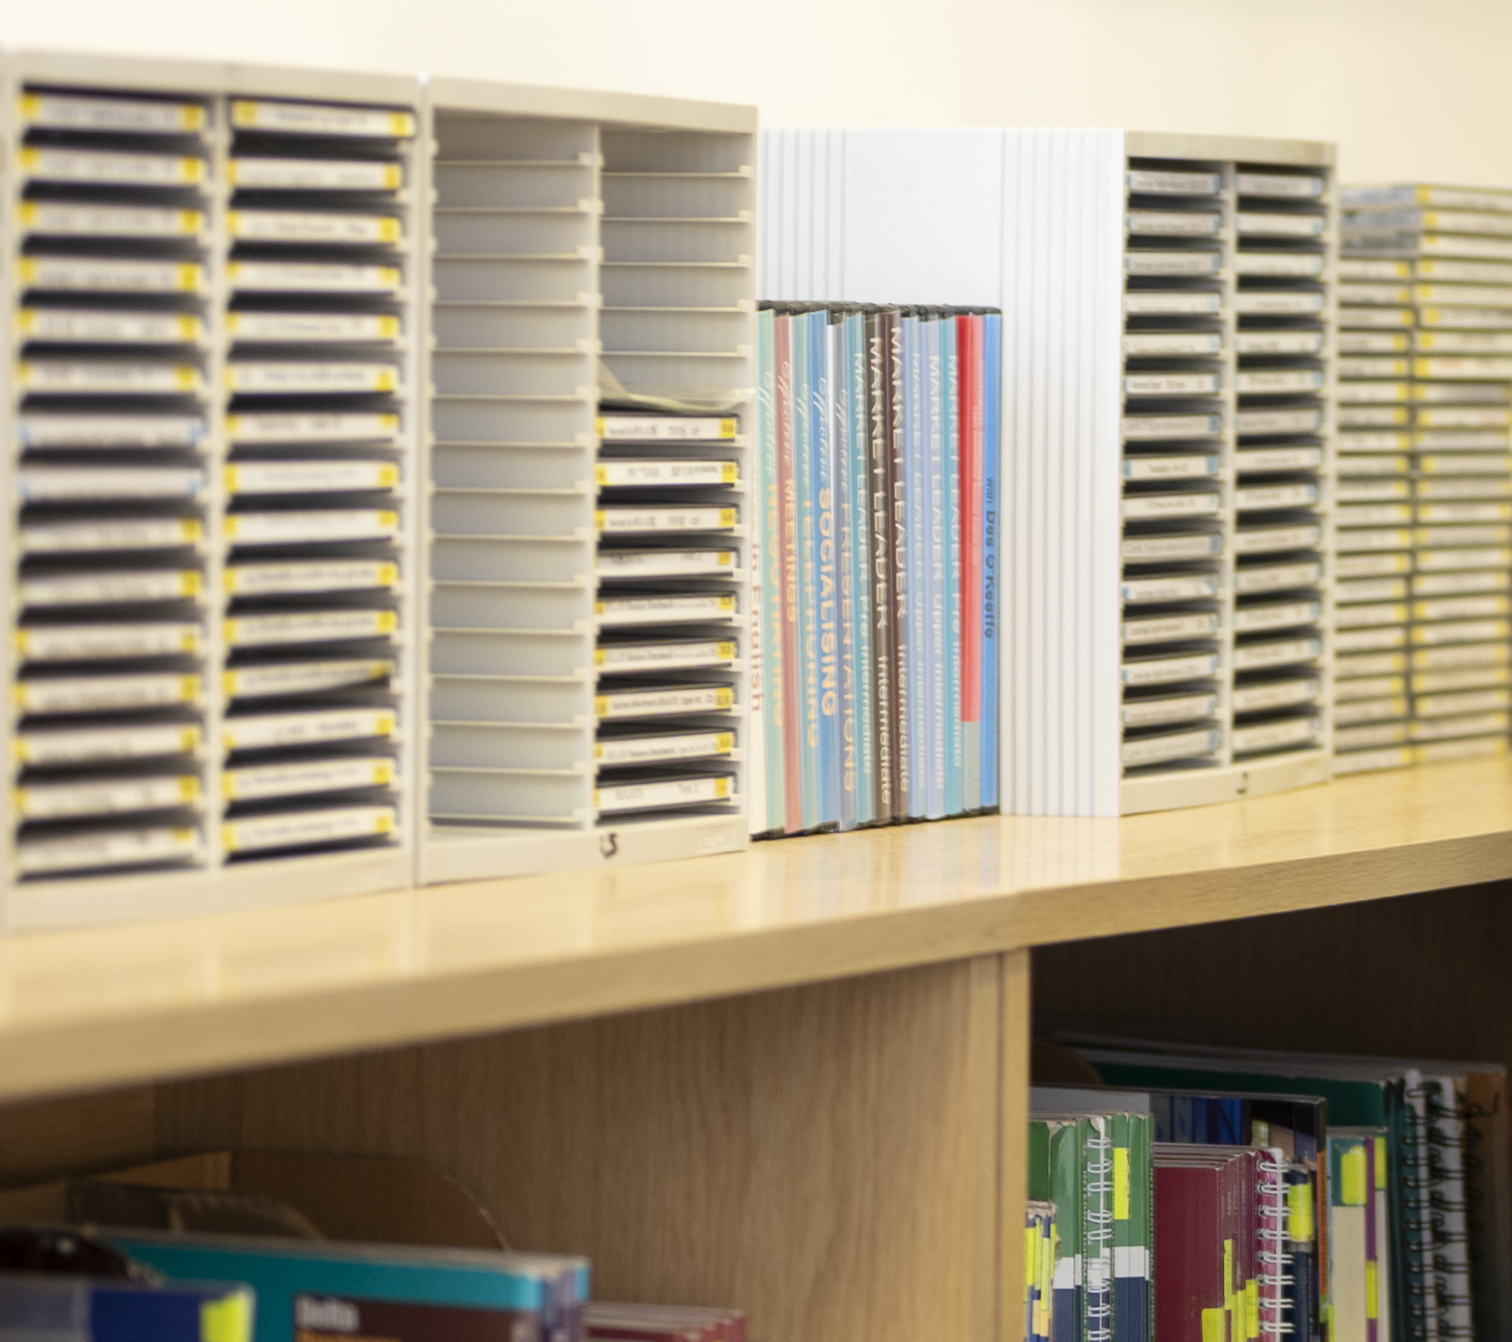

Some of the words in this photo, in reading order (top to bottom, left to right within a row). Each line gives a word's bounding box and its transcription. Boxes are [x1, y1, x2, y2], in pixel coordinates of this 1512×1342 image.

[854, 352, 866, 460] MARKET
[870, 336, 886, 474] MARKET
[891, 326, 904, 464] MARKET
[929, 355, 941, 461] MARKET
[948, 354, 959, 461] MARKET
[785, 478, 798, 622] MEETINGS
[857, 474, 869, 581] LEADER
[874, 491, 888, 629] LEADER
[894, 480, 907, 619] LEADER
[931, 475, 943, 581] LEADER
[950, 474, 961, 579] LEADER
[819, 487, 838, 717] SOCIALISING
[841, 503, 856, 793] PRESENTATIONS
[861, 646, 872, 773] Intermediate
[878, 655, 893, 805] Intermediate
[897, 645, 910, 792] Intermediate
[933, 663, 945, 790] Intermediate
